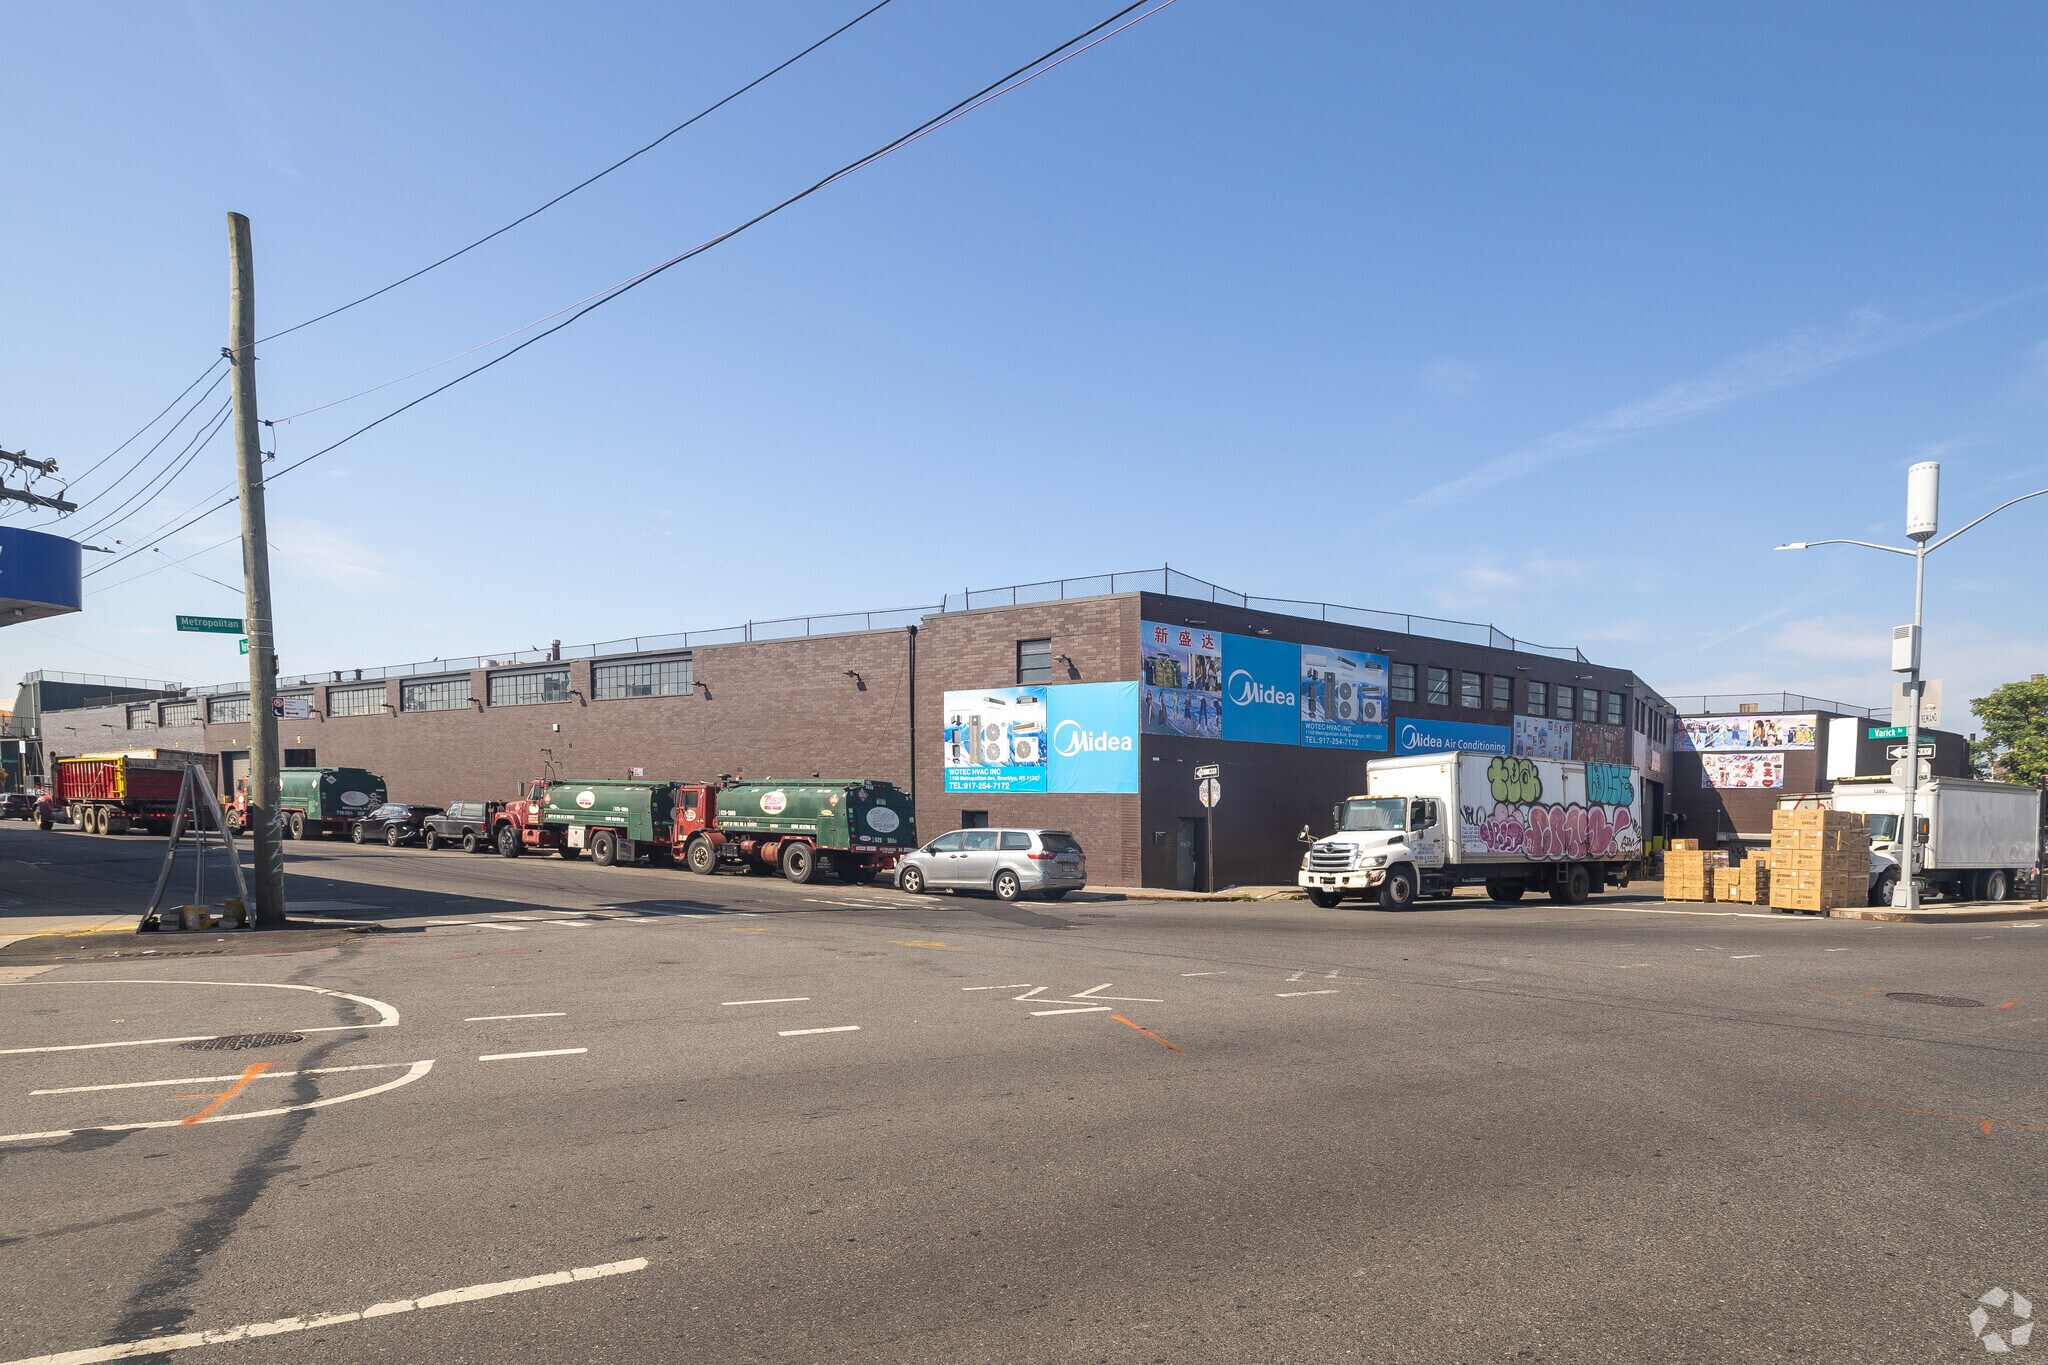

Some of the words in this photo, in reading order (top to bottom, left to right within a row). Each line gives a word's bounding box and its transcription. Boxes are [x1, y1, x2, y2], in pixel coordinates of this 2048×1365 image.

[181, 617, 239, 628] Metropolitan
[1154, 625, 1215, 650] 新盛达
[1240, 681, 1295, 706] Midea
[1063, 730, 1132, 752] Midea
[1408, 732, 1442, 747] Midea
[1444, 738, 1456, 748] Air
[1457, 739, 1506, 754] Conditioning
[1874, 729, 1896, 737] Varick
[949, 782, 1010, 790] TEL:917-254-7172
